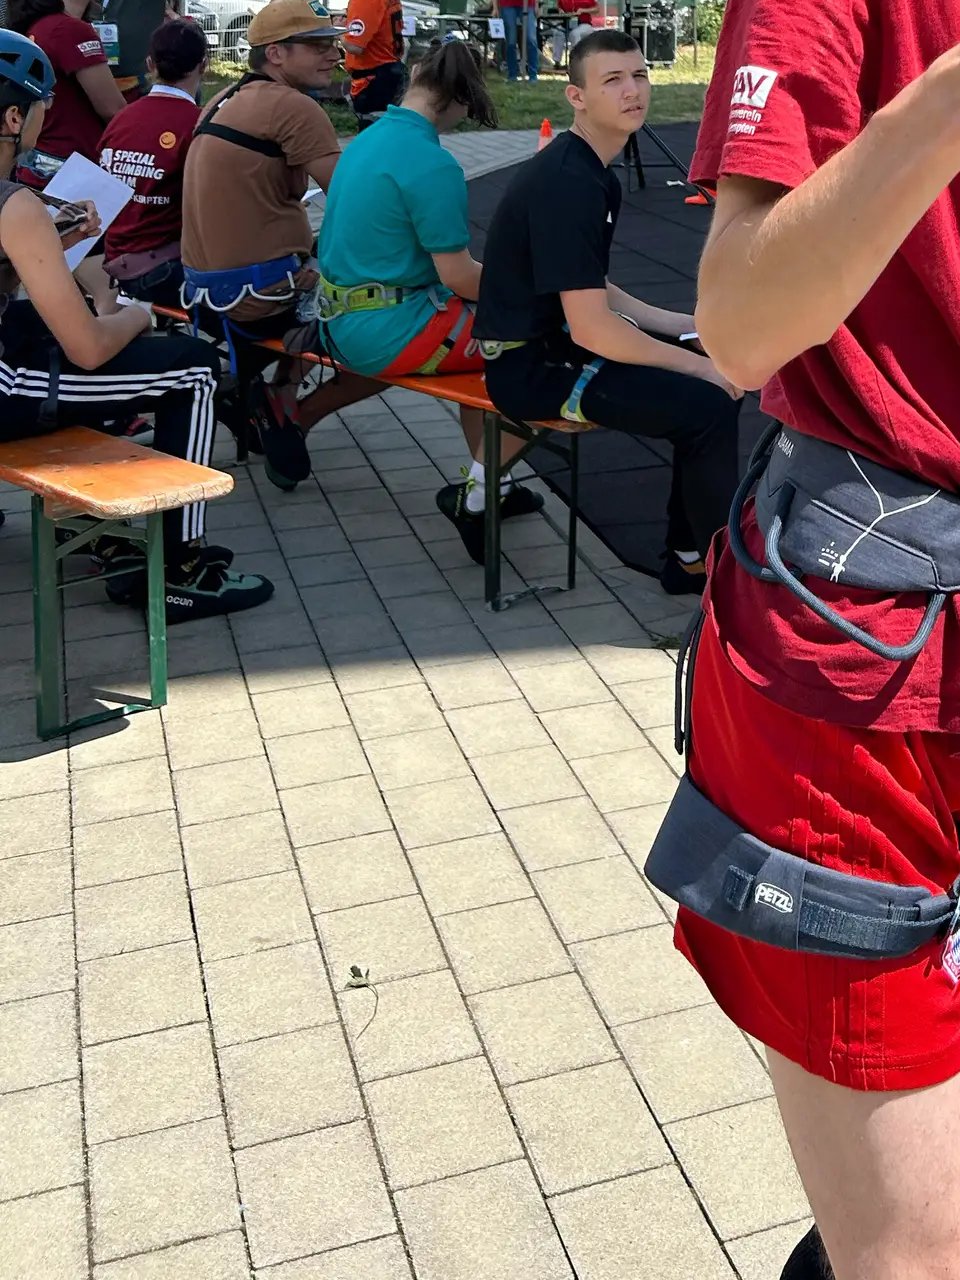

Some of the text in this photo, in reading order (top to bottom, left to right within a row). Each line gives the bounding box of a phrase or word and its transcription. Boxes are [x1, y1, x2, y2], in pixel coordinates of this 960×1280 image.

[734, 71, 769, 99] AV
[113, 150, 156, 166] SPECIAL
[113, 162, 165, 180] CLIMBING
[755, 884, 793, 913] PETZL
